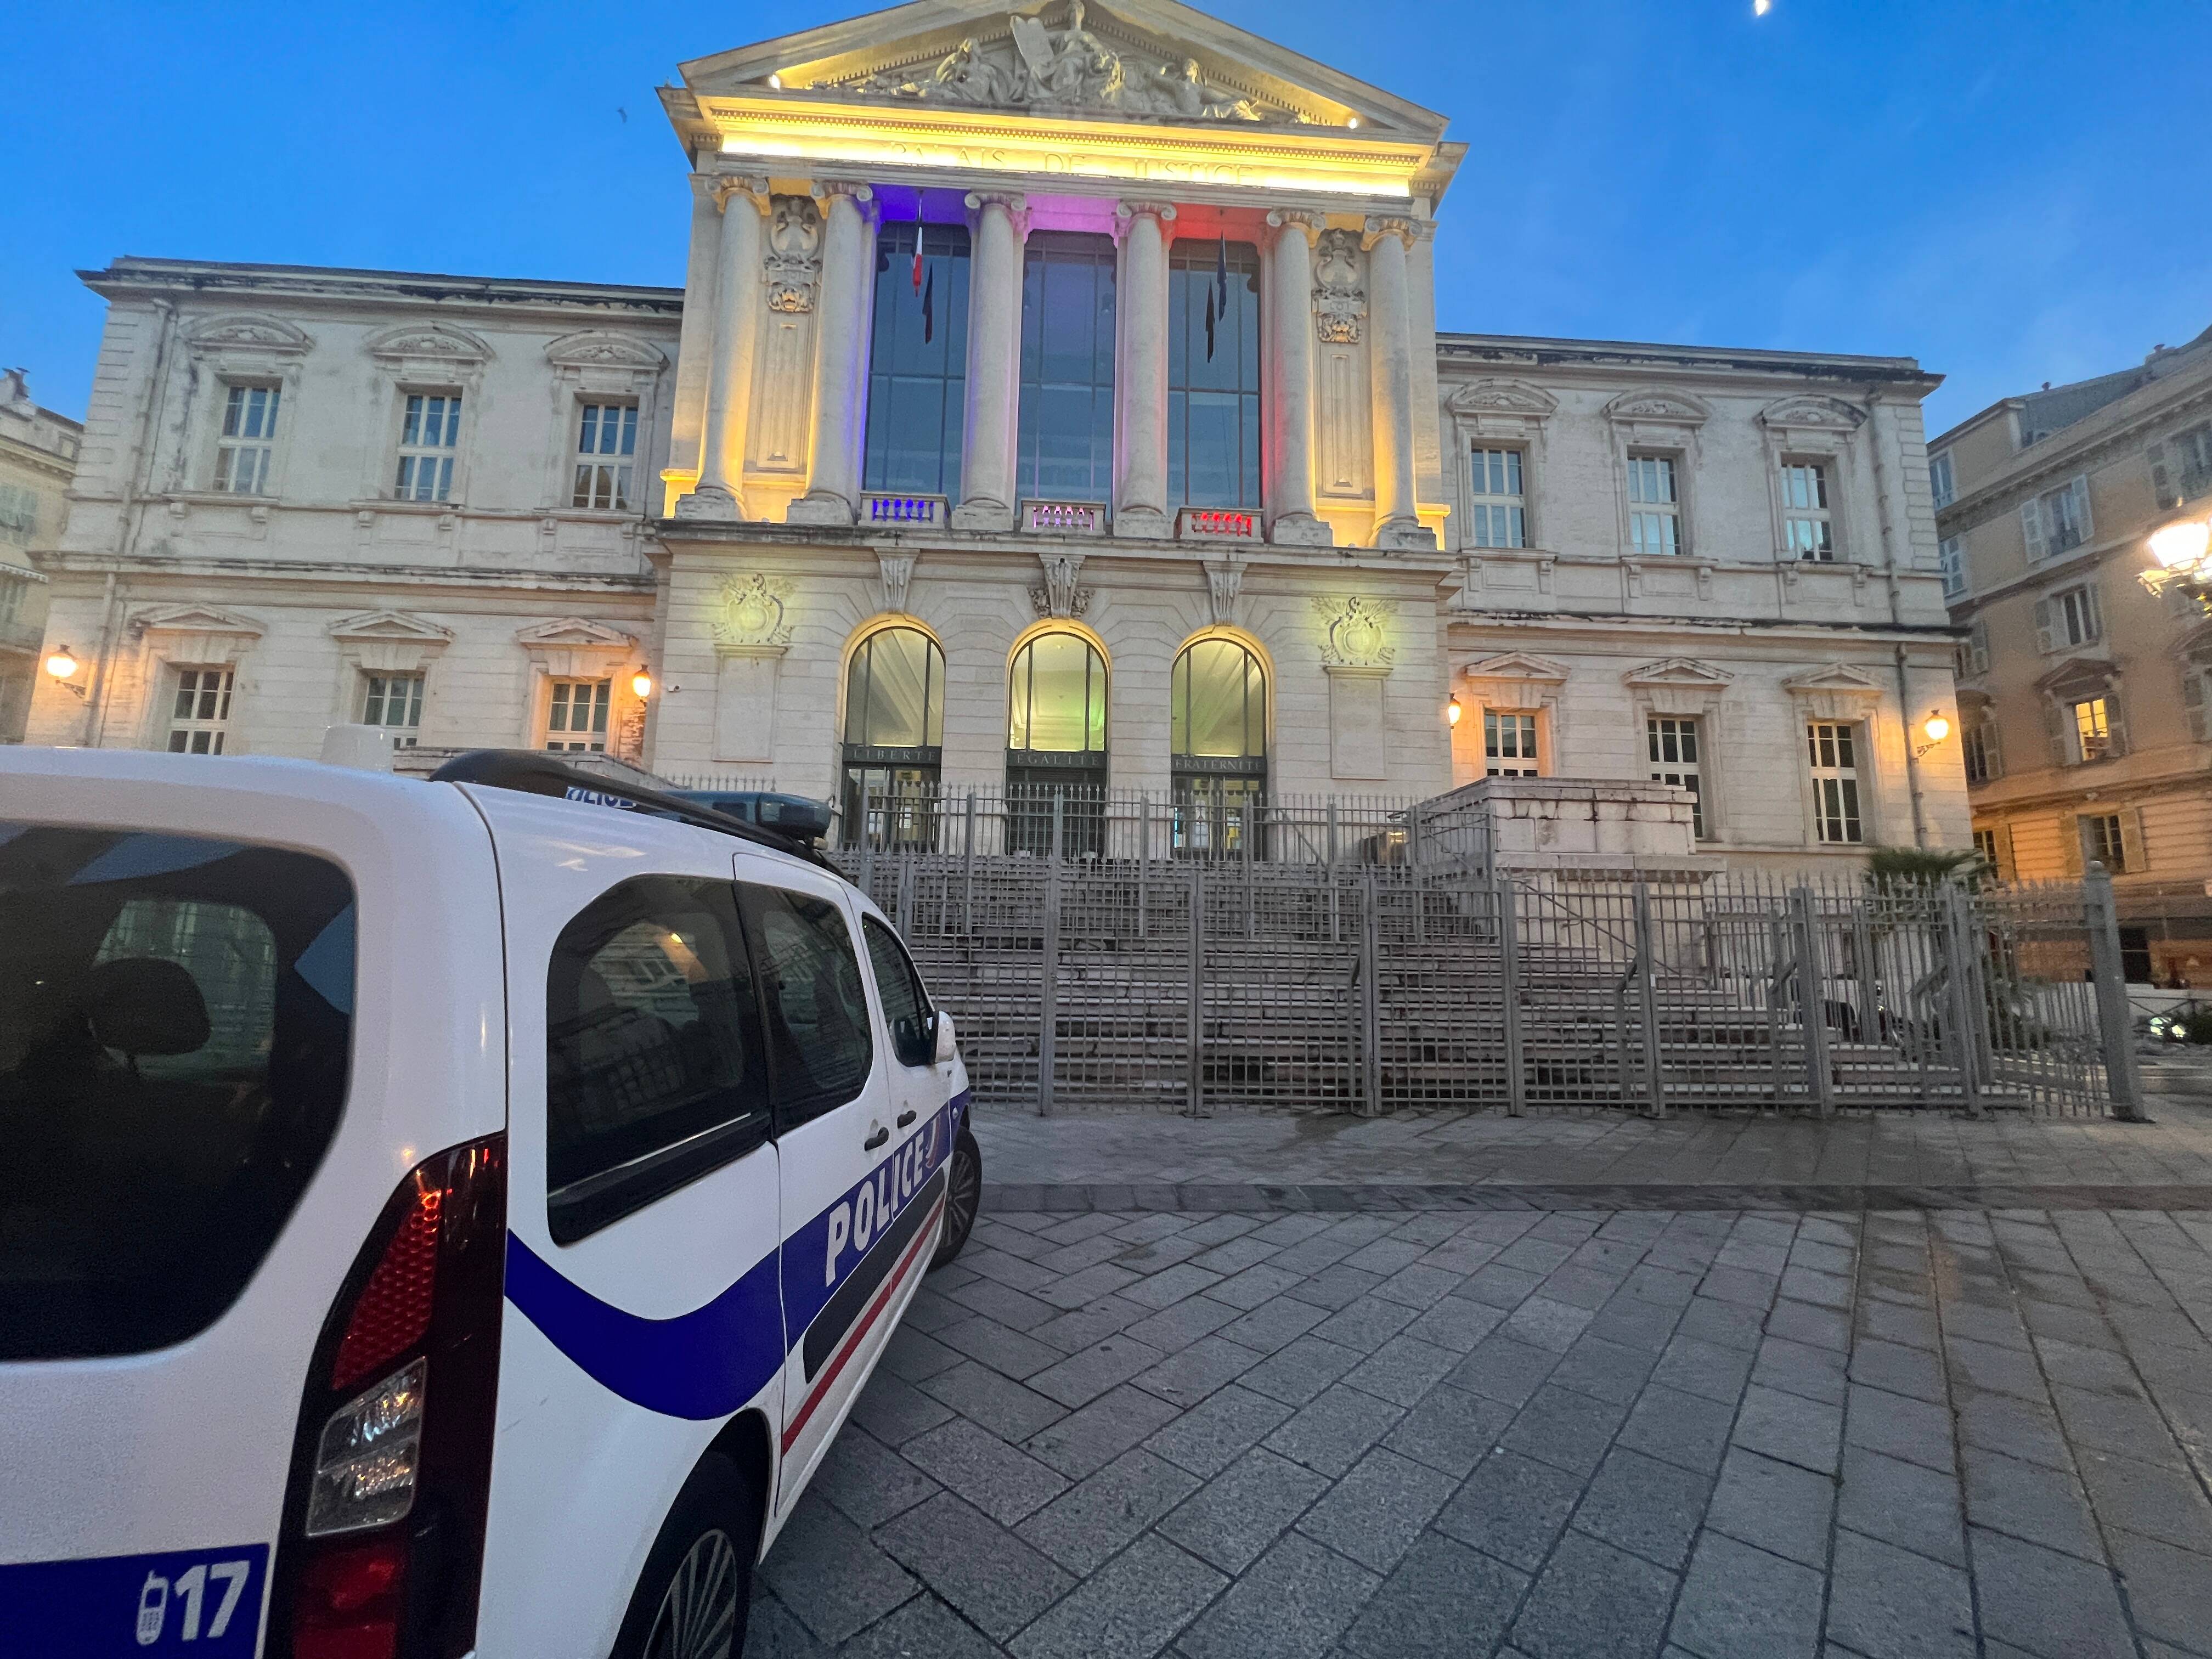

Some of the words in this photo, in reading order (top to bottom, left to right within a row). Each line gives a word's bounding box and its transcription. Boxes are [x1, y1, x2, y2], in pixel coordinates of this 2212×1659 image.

[890, 141, 1008, 166] PAAIS
[1044, 152, 1085, 173] DE
[567, 788, 633, 807] OLIC
[825, 1131, 924, 1287] POLICE
[174, 1560, 250, 1641] 17
